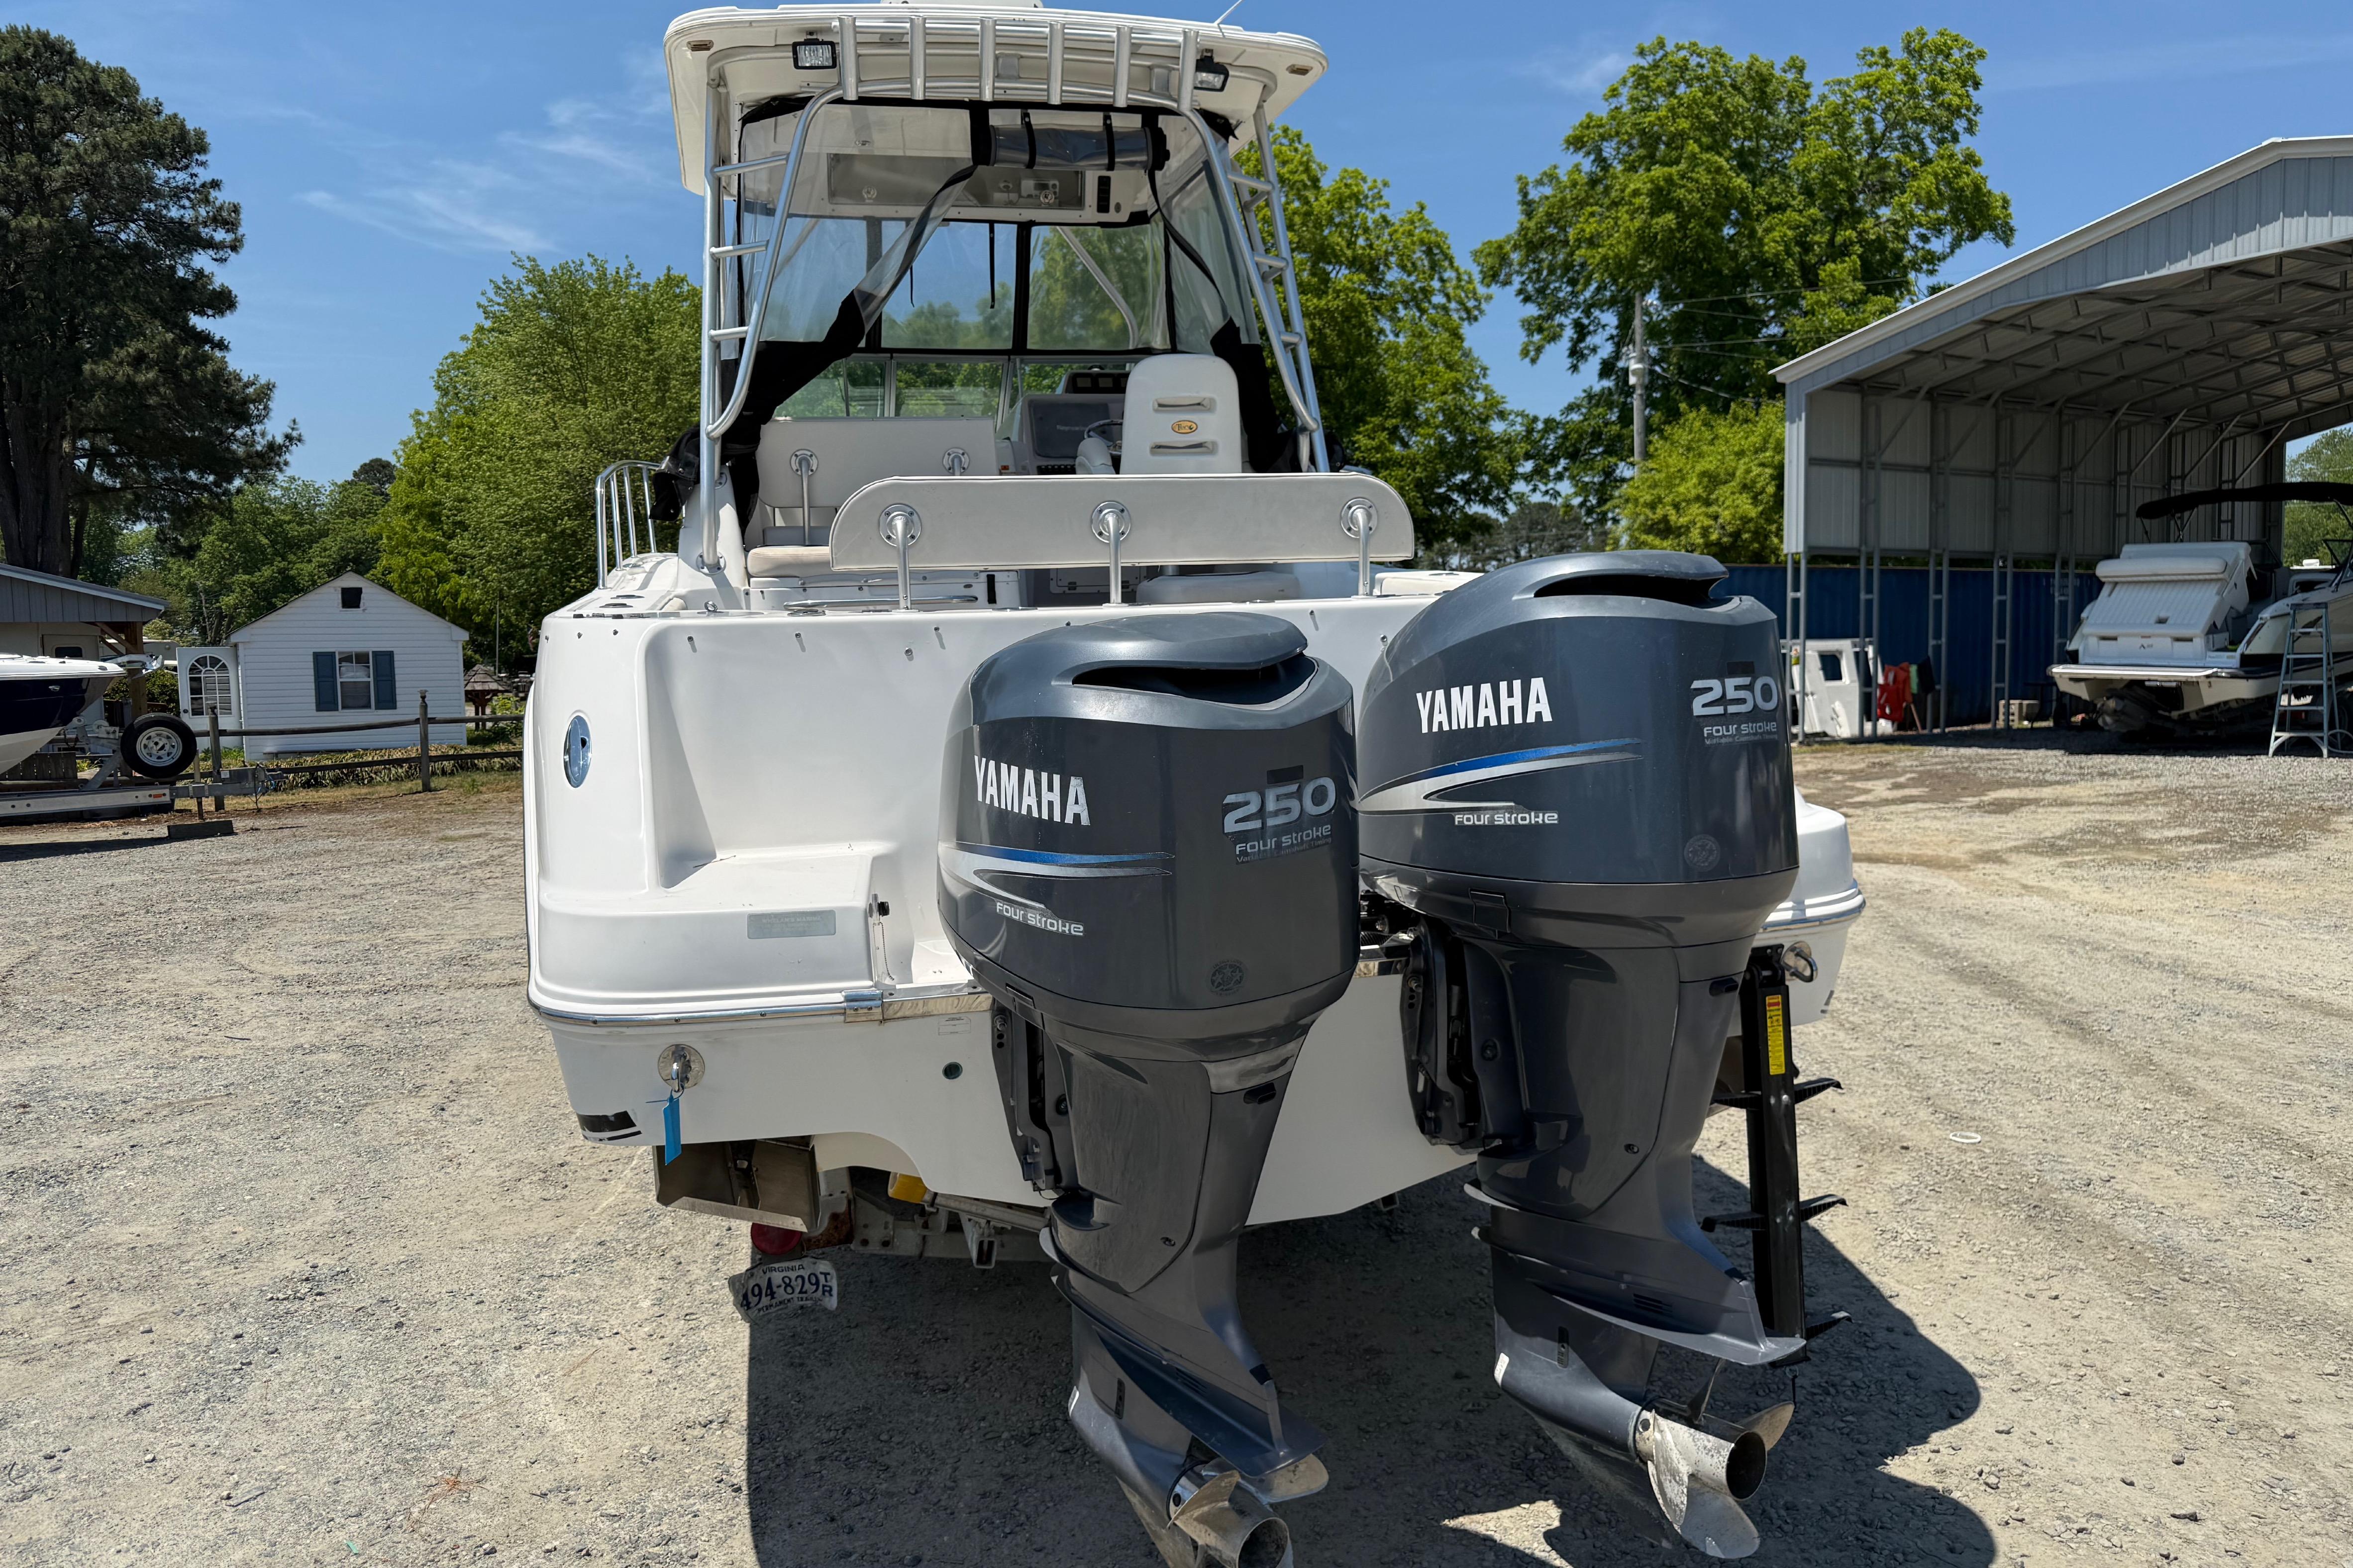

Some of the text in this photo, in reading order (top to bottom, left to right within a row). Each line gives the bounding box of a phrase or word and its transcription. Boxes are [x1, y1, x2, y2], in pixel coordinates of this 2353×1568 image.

[1416, 677, 1552, 733] YAMAHA
[1690, 676, 1778, 716] 250
[974, 755, 1090, 826] YAMAHA
[1223, 777, 1336, 833] 250
[740, 1273, 820, 1311] 494-829
[762, 1264, 805, 1274] VIRGINIA
